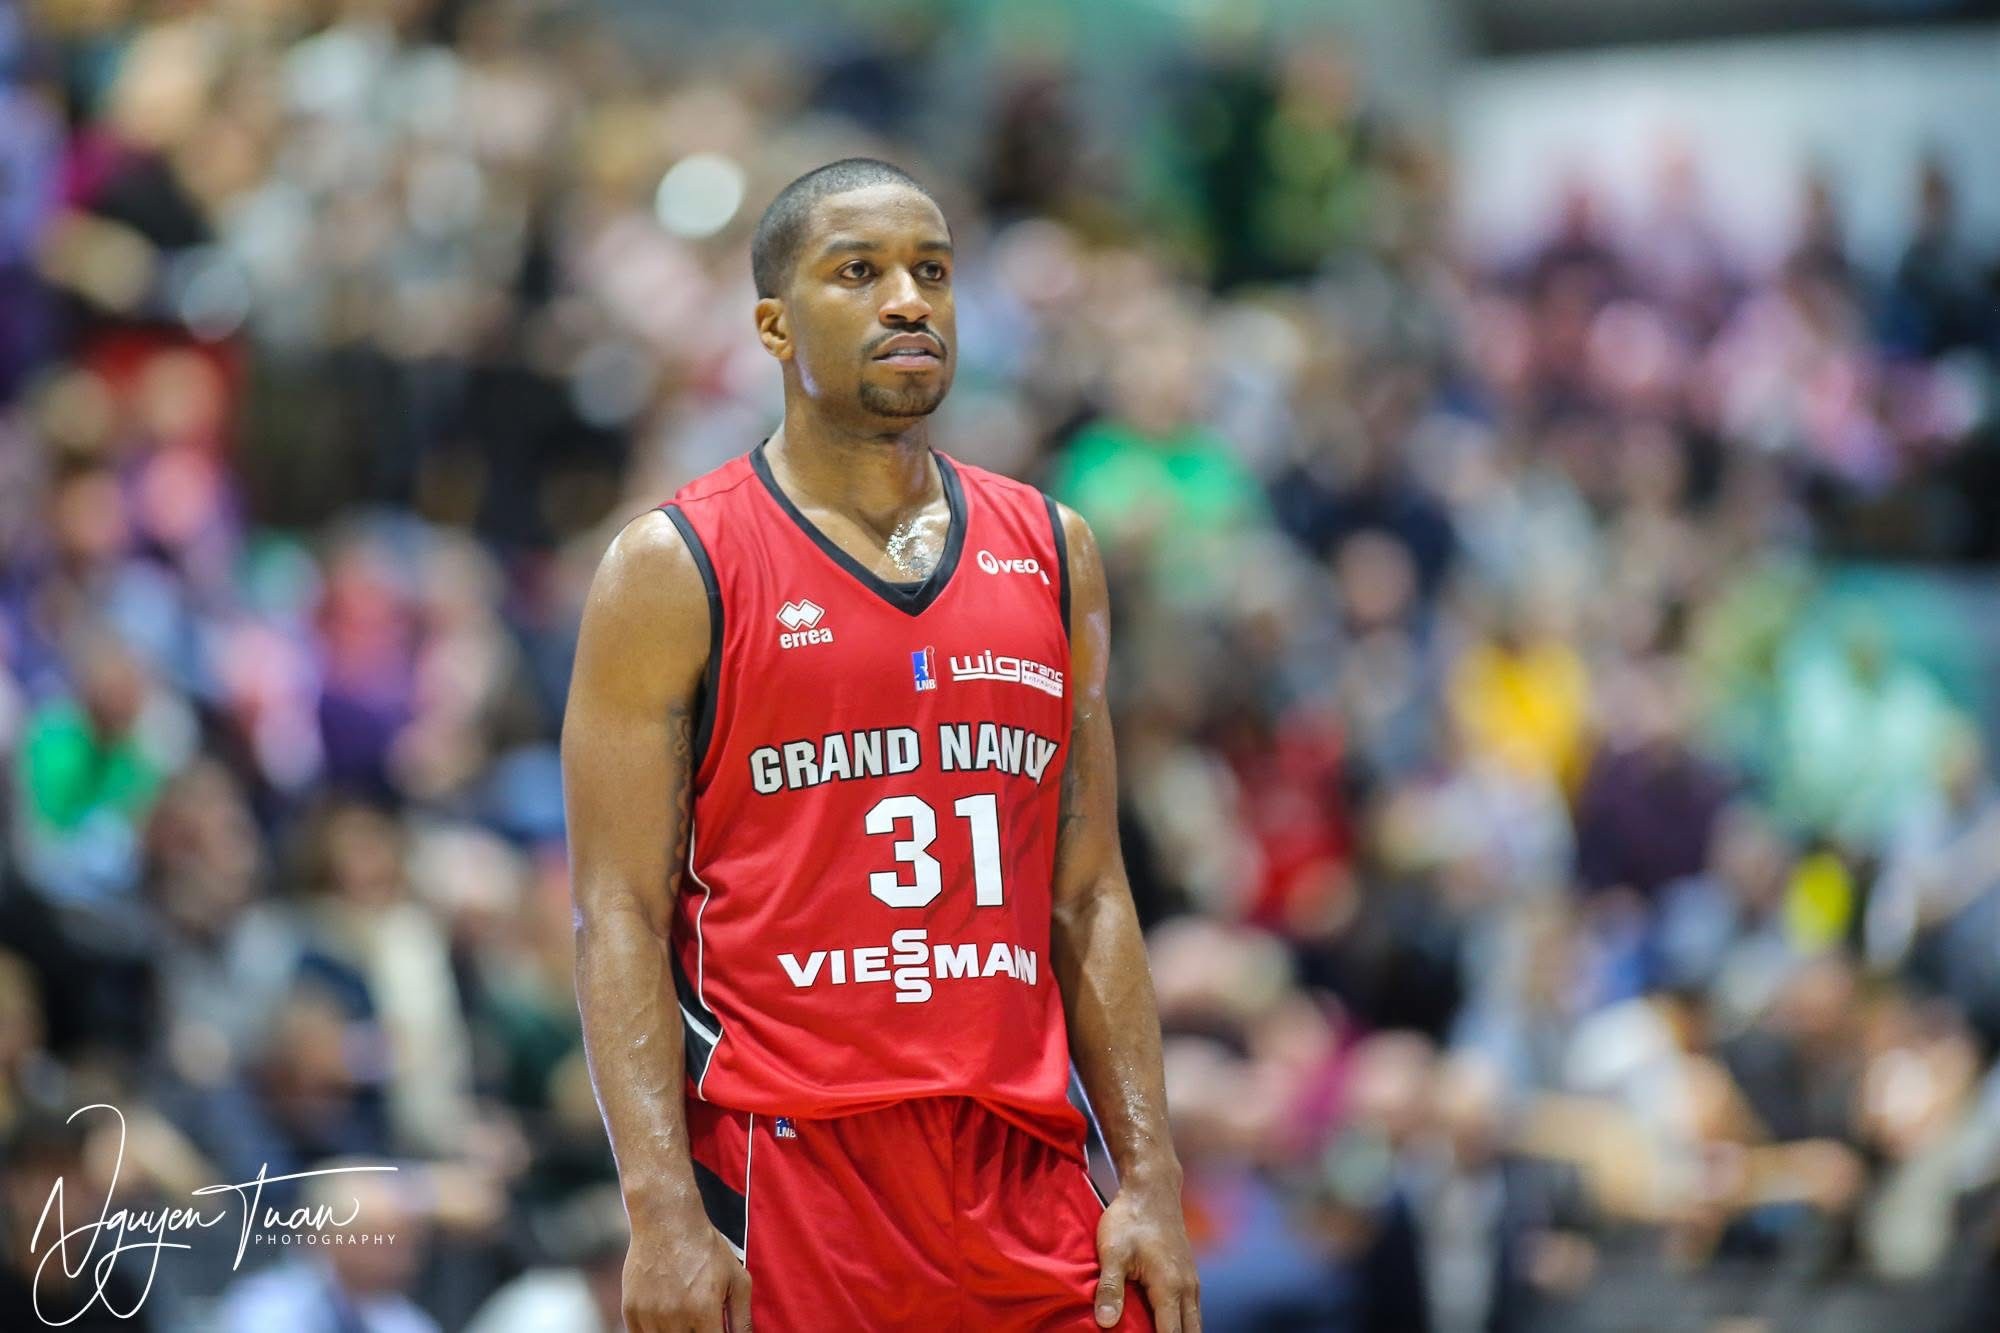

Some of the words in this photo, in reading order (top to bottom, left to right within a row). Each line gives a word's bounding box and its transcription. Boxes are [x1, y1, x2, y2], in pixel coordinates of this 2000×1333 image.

[780, 627, 834, 649] errea
[749, 726, 921, 795] GRAND
[938, 721, 1059, 785] NANCY
[864, 793, 1005, 909] 31
[776, 1126, 796, 1138] LNB
